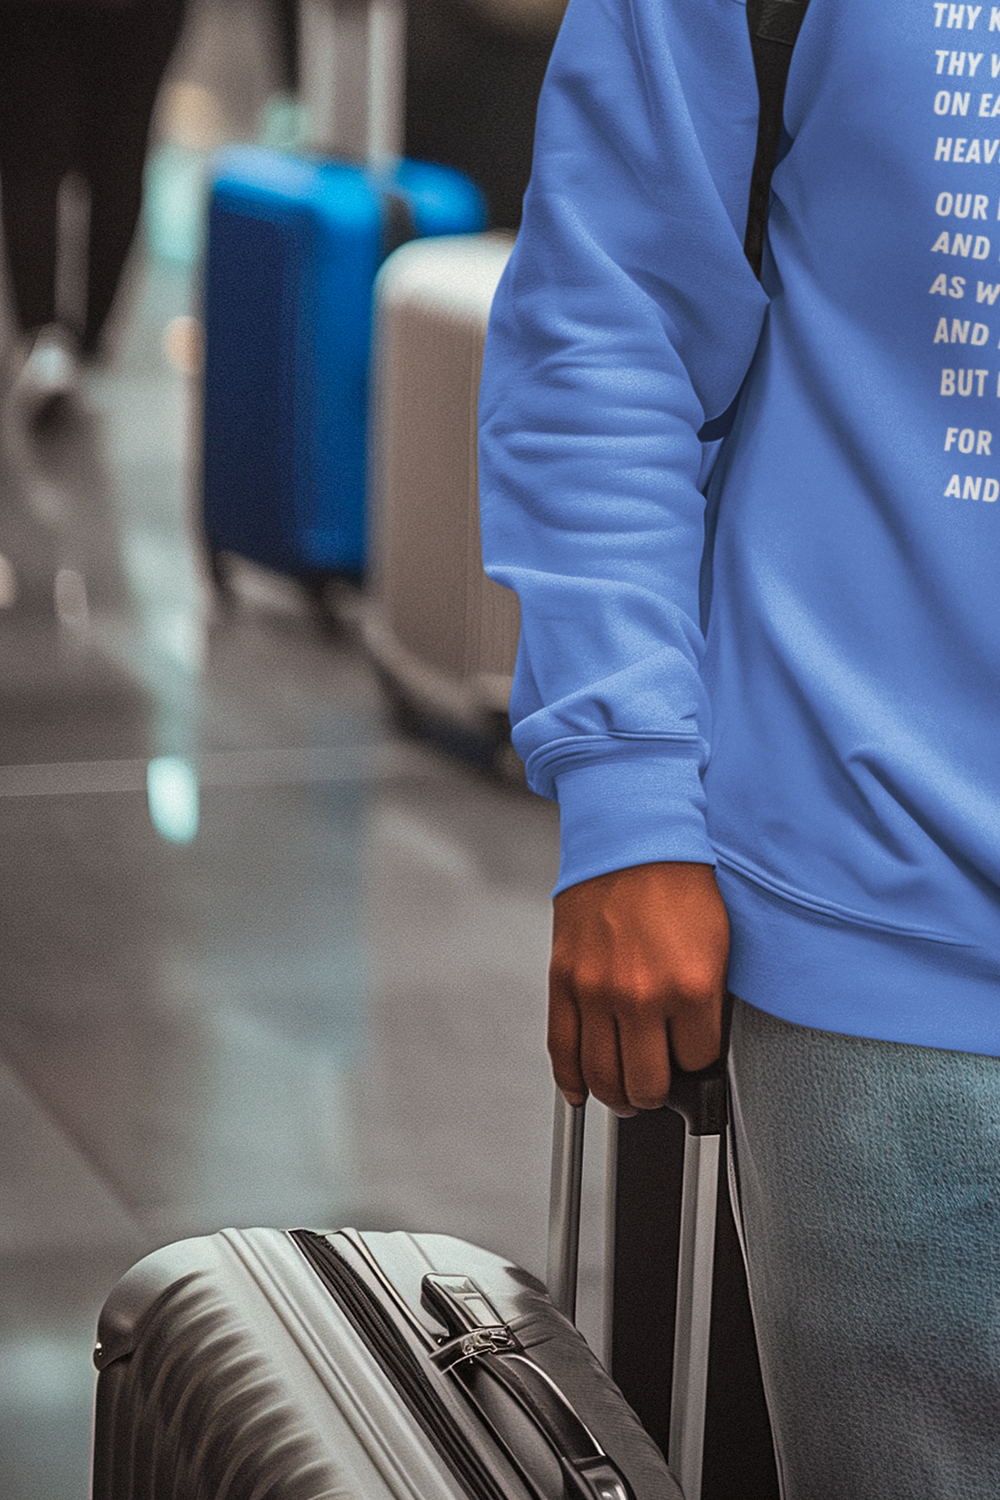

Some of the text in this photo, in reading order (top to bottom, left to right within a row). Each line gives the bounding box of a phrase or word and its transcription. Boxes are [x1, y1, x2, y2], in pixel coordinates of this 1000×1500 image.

[933, 2, 983, 30] THY
[935, 49, 984, 77] THY
[933, 90, 971, 117] ON
[934, 191, 989, 220] OUR
[930, 230, 991, 260] AND
[928, 272, 967, 300] AS
[932, 316, 990, 347] AND
[939, 367, 990, 398] BUT
[943, 426, 993, 456] FOR
[943, 474, 1000, 503] AND
